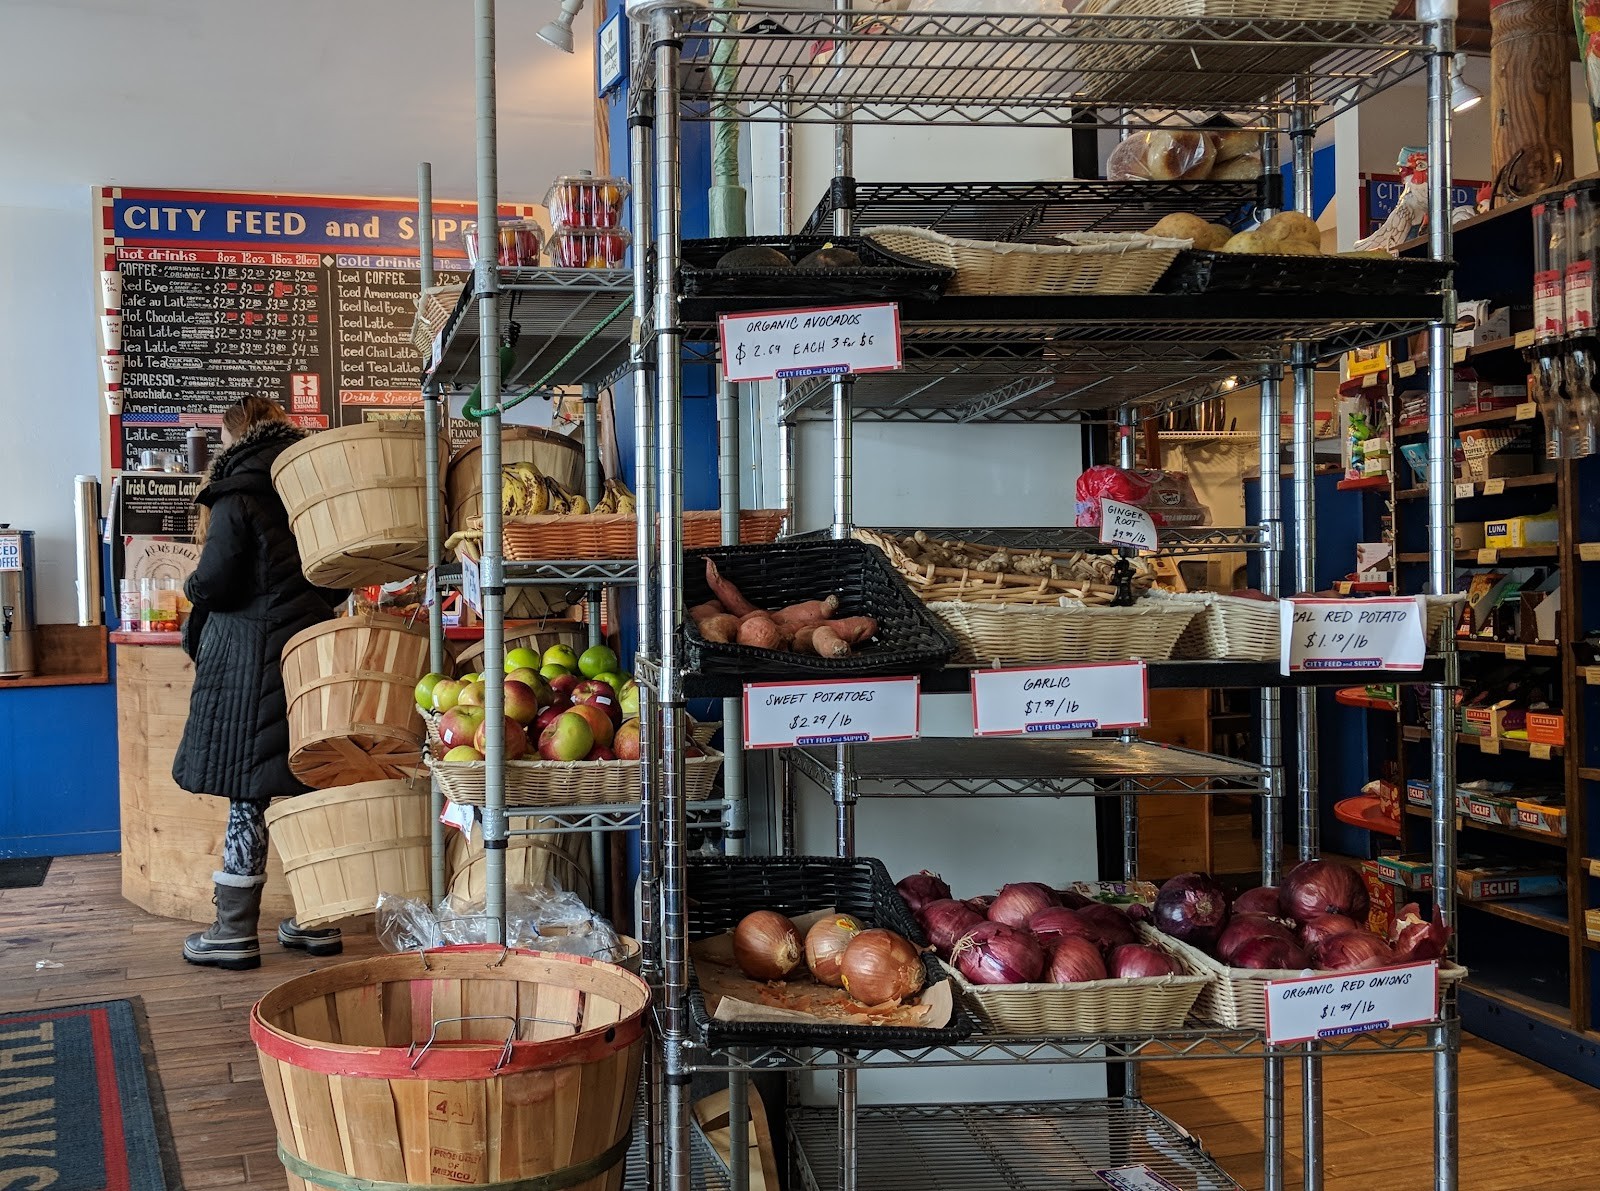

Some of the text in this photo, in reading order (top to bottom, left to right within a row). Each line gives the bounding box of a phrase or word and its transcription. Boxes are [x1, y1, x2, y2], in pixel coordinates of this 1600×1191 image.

[1377, 183, 1404, 200] CIT
[123, 205, 207, 232] CITY
[226, 210, 307, 236] FEED
[325, 216, 380, 239] and
[120, 248, 318, 265] hot drinks 8oz 12oz 16oz 20oz
[338, 256, 370, 267] cold
[376, 257, 421, 268] drinks
[118, 262, 158, 277] COFFEE
[338, 270, 406, 285] Iced COFFEE
[121, 279, 168, 294] Red Eye
[338, 286, 419, 300] Iced Americano
[121, 293, 147, 307] Café
[149, 299, 161, 307] au
[164, 295, 186, 308] Lait
[338, 300, 405, 315] Iced Red Eye
[122, 309, 195, 324] Hot Chocolate
[339, 315, 394, 329] Iced Latte
[746, 314, 862, 332] ORGANIC AVOCADOS
[122, 324, 146, 338] Chai
[148, 325, 180, 338] Latte
[339, 330, 362, 342] Iced
[364, 331, 398, 344] Mocha
[122, 340, 142, 352] Tea
[144, 340, 178, 352] Latte
[340, 344, 418, 358] Iced Chai Latte
[793, 340, 826, 356] EACH
[832, 337, 840, 349] 3
[859, 332, 874, 347] $6
[122, 354, 166, 368] Hot Tea
[340, 361, 420, 373] Iced Tea Latte
[777, 370, 794, 378] CITY
[795, 368, 812, 377] FEED
[822, 366, 848, 374] SUPPLY
[122, 373, 174, 386] ESPRESSO
[340, 375, 390, 387] Iced Tea
[124, 388, 172, 400] Macchiato
[294, 396, 318, 404] EQUAL
[342, 392, 422, 404] Drink Specia
[124, 402, 181, 414] Americano
[125, 428, 158, 440] Latte
[451, 429, 479, 438] FLAVOR
[126, 478, 201, 496] Irish Cream Latte
[1107, 505, 1146, 520] GINGER
[1114, 516, 1140, 528] ROOT
[1488, 524, 1506, 534] LUNA
[1292, 610, 1407, 624] CAL RED POTATO
[1304, 660, 1323, 668] CITY
[1324, 660, 1342, 668] FEED
[1024, 676, 1072, 691] GARLIC
[766, 690, 876, 706] SWEET POTATOES
[1026, 724, 1044, 732] CITY
[1044, 723, 1062, 731] FEED
[815, 736, 833, 744] FEED
[842, 734, 868, 742] SUPPLY
[1411, 788, 1424, 799] CLIF
[1476, 804, 1490, 817] CLIF
[1522, 812, 1538, 824] CLIF
[1382, 867, 1395, 878] CLIF
[1489, 882, 1517, 894] CLIF
[1282, 973, 1412, 1000] ORGANIC RED ONIONS
[1318, 1029, 1336, 1038] CITY
[1336, 1027, 1353, 1035] FEED
[1363, 1022, 1388, 1031] SUPPLY
[436, 1100, 448, 1114] 4
[434, 1149, 479, 1164] PRODUCE
[432, 1166, 470, 1180] MEXICO
